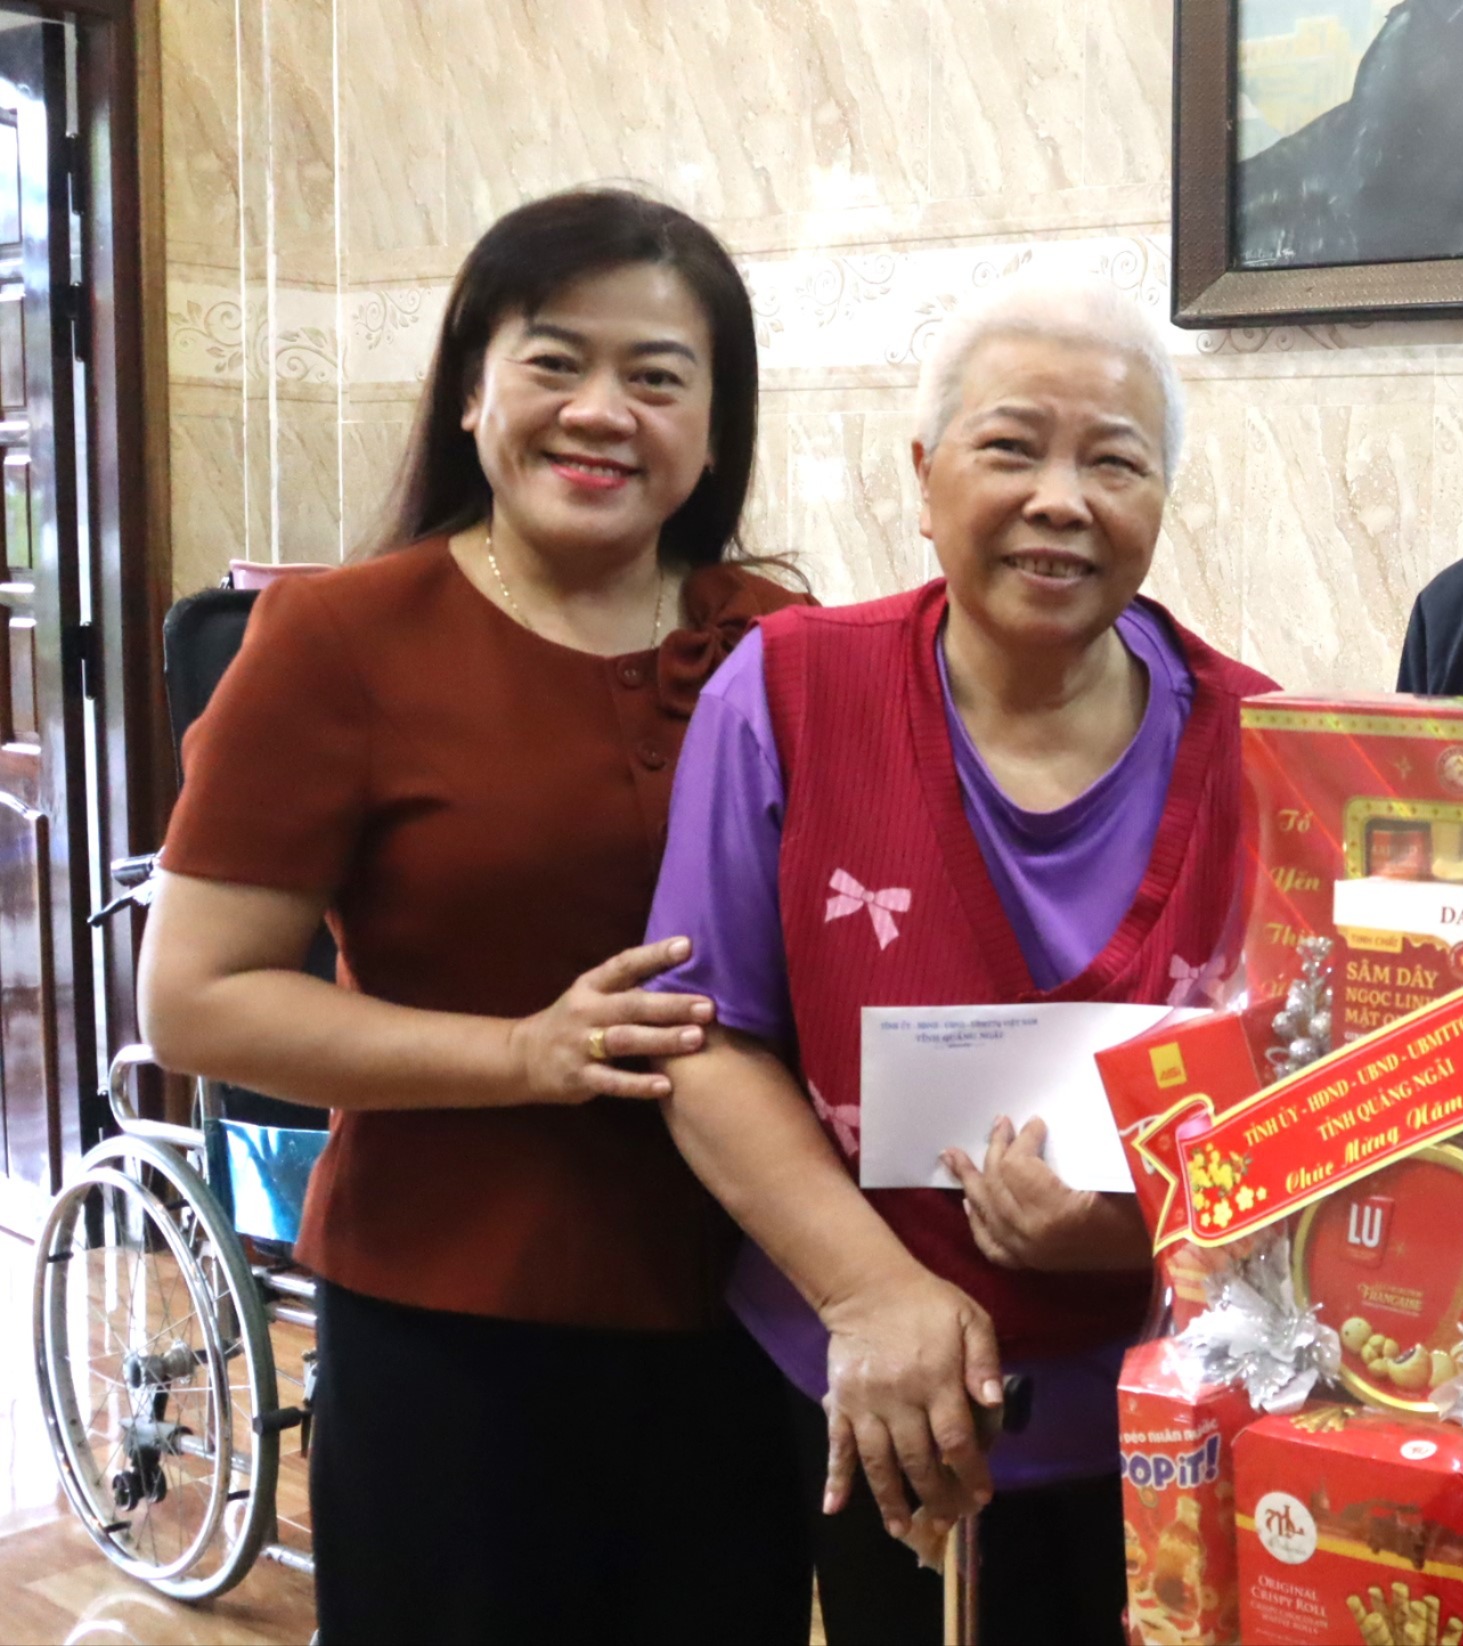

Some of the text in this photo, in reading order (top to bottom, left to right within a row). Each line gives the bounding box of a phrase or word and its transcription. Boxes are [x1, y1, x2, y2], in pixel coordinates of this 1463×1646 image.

[1346, 958, 1439, 989] SÂM DÂY
[1345, 987, 1392, 1008] NGỌC
[1345, 1006, 1381, 1028] MẬT
[1243, 1118, 1279, 1147] TỈNH
[1278, 1105, 1299, 1128] ỦY
[1357, 1053, 1400, 1085] UBND
[1317, 1057, 1456, 1142] TỈNH QUẢNG NGÃI
[1285, 1161, 1335, 1195] Chúc
[1341, 1126, 1400, 1169] Mừng
[1406, 1095, 1463, 1130] Năm
[1347, 1202, 1384, 1248] LU
[1258, 1574, 1318, 1601] ORIGINAL
